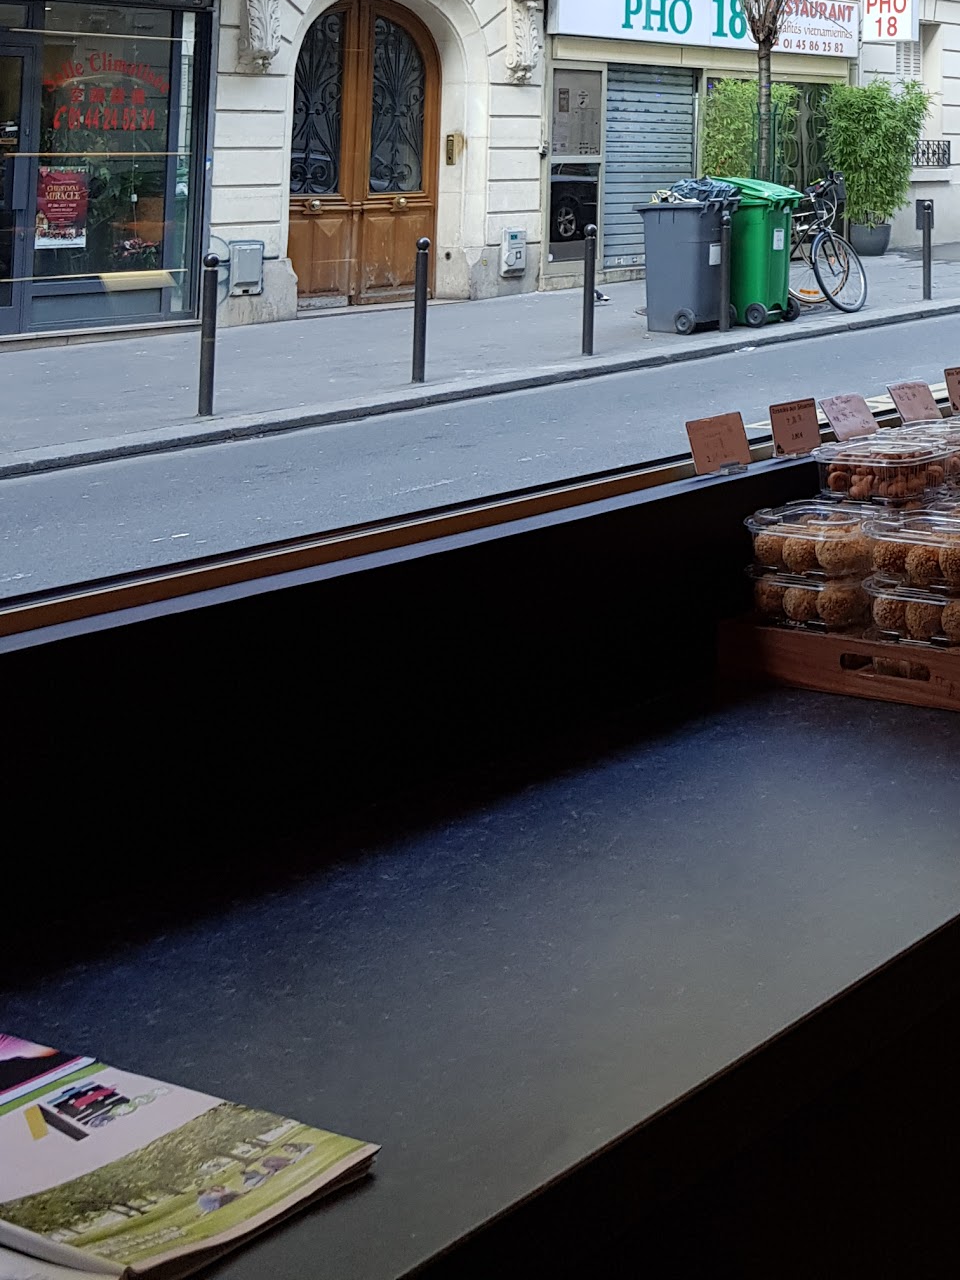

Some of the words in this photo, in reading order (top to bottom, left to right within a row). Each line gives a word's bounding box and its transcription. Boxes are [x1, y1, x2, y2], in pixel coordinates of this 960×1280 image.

[803, 23, 853, 40] vietnamiennes
[874, 16, 898, 38] 18
[783, 38, 793, 49] 01
[796, 39, 806, 50] 45
[809, 40, 820, 52] 86
[822, 42, 832, 52] 25
[834, 42, 844, 53] 82
[85, 107, 99, 130] 44
[103, 107, 118, 131] 24
[122, 107, 136, 131] 52
[46, 192, 81, 200] MIRACLE
